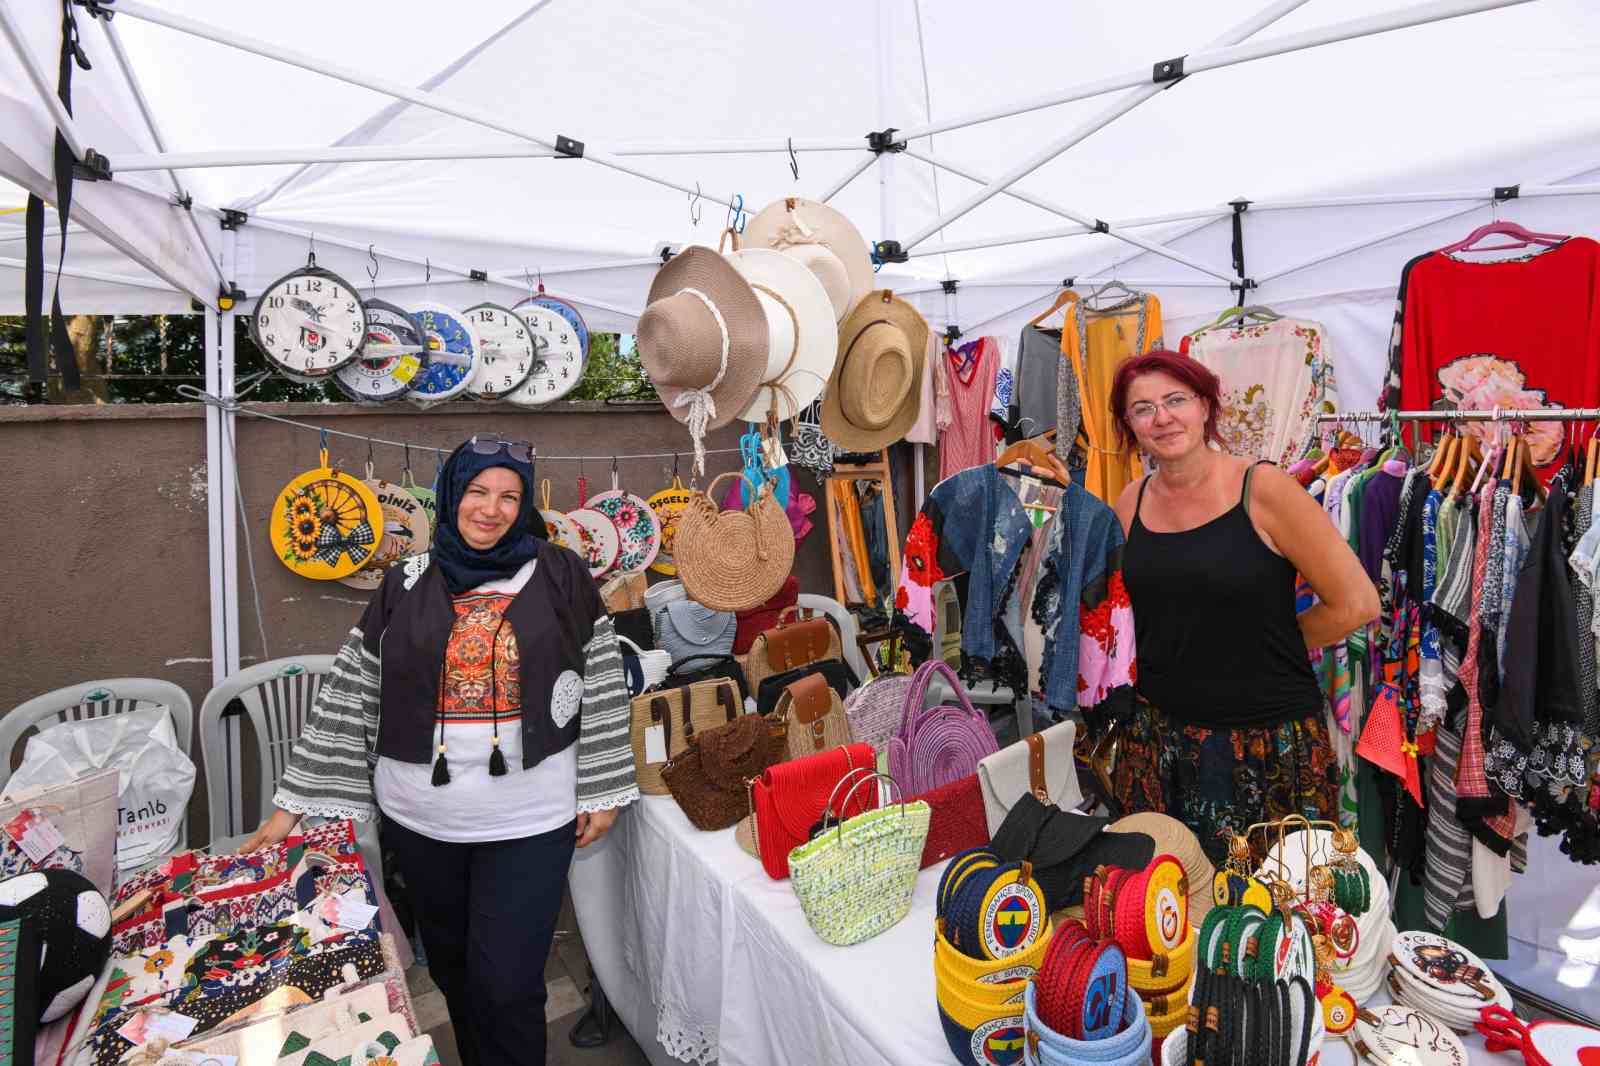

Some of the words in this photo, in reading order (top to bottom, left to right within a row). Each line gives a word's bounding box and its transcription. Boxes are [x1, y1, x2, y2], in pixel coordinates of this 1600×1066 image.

[285, 283, 300, 296] 11
[304, 279, 322, 293] 12
[332, 287, 339, 299] 1
[268, 296, 284, 309] 10
[346, 302, 356, 313] 2
[260, 315, 270, 328] 9
[367, 313, 381, 324] 12
[480, 311, 494, 322] 12
[504, 313, 508, 327] 1
[526, 315, 539, 327] 12
[352, 320, 361, 333] 3
[547, 319, 553, 332] 1
[455, 329, 462, 337] 2
[515, 328, 524, 339] 2
[559, 333, 568, 345] 2
[265, 334, 275, 346] 8
[345, 338, 354, 349] 4
[282, 348, 292, 362] 7
[328, 351, 338, 363] 5
[566, 351, 574, 362] 3
[304, 357, 314, 369] 6
[519, 360, 526, 374] 4
[560, 367, 568, 378] 4
[371, 379, 381, 390] 6
[484, 381, 493, 393] 6
[503, 375, 512, 387] 5
[546, 379, 556, 391] 5
[528, 383, 536, 396] 6
